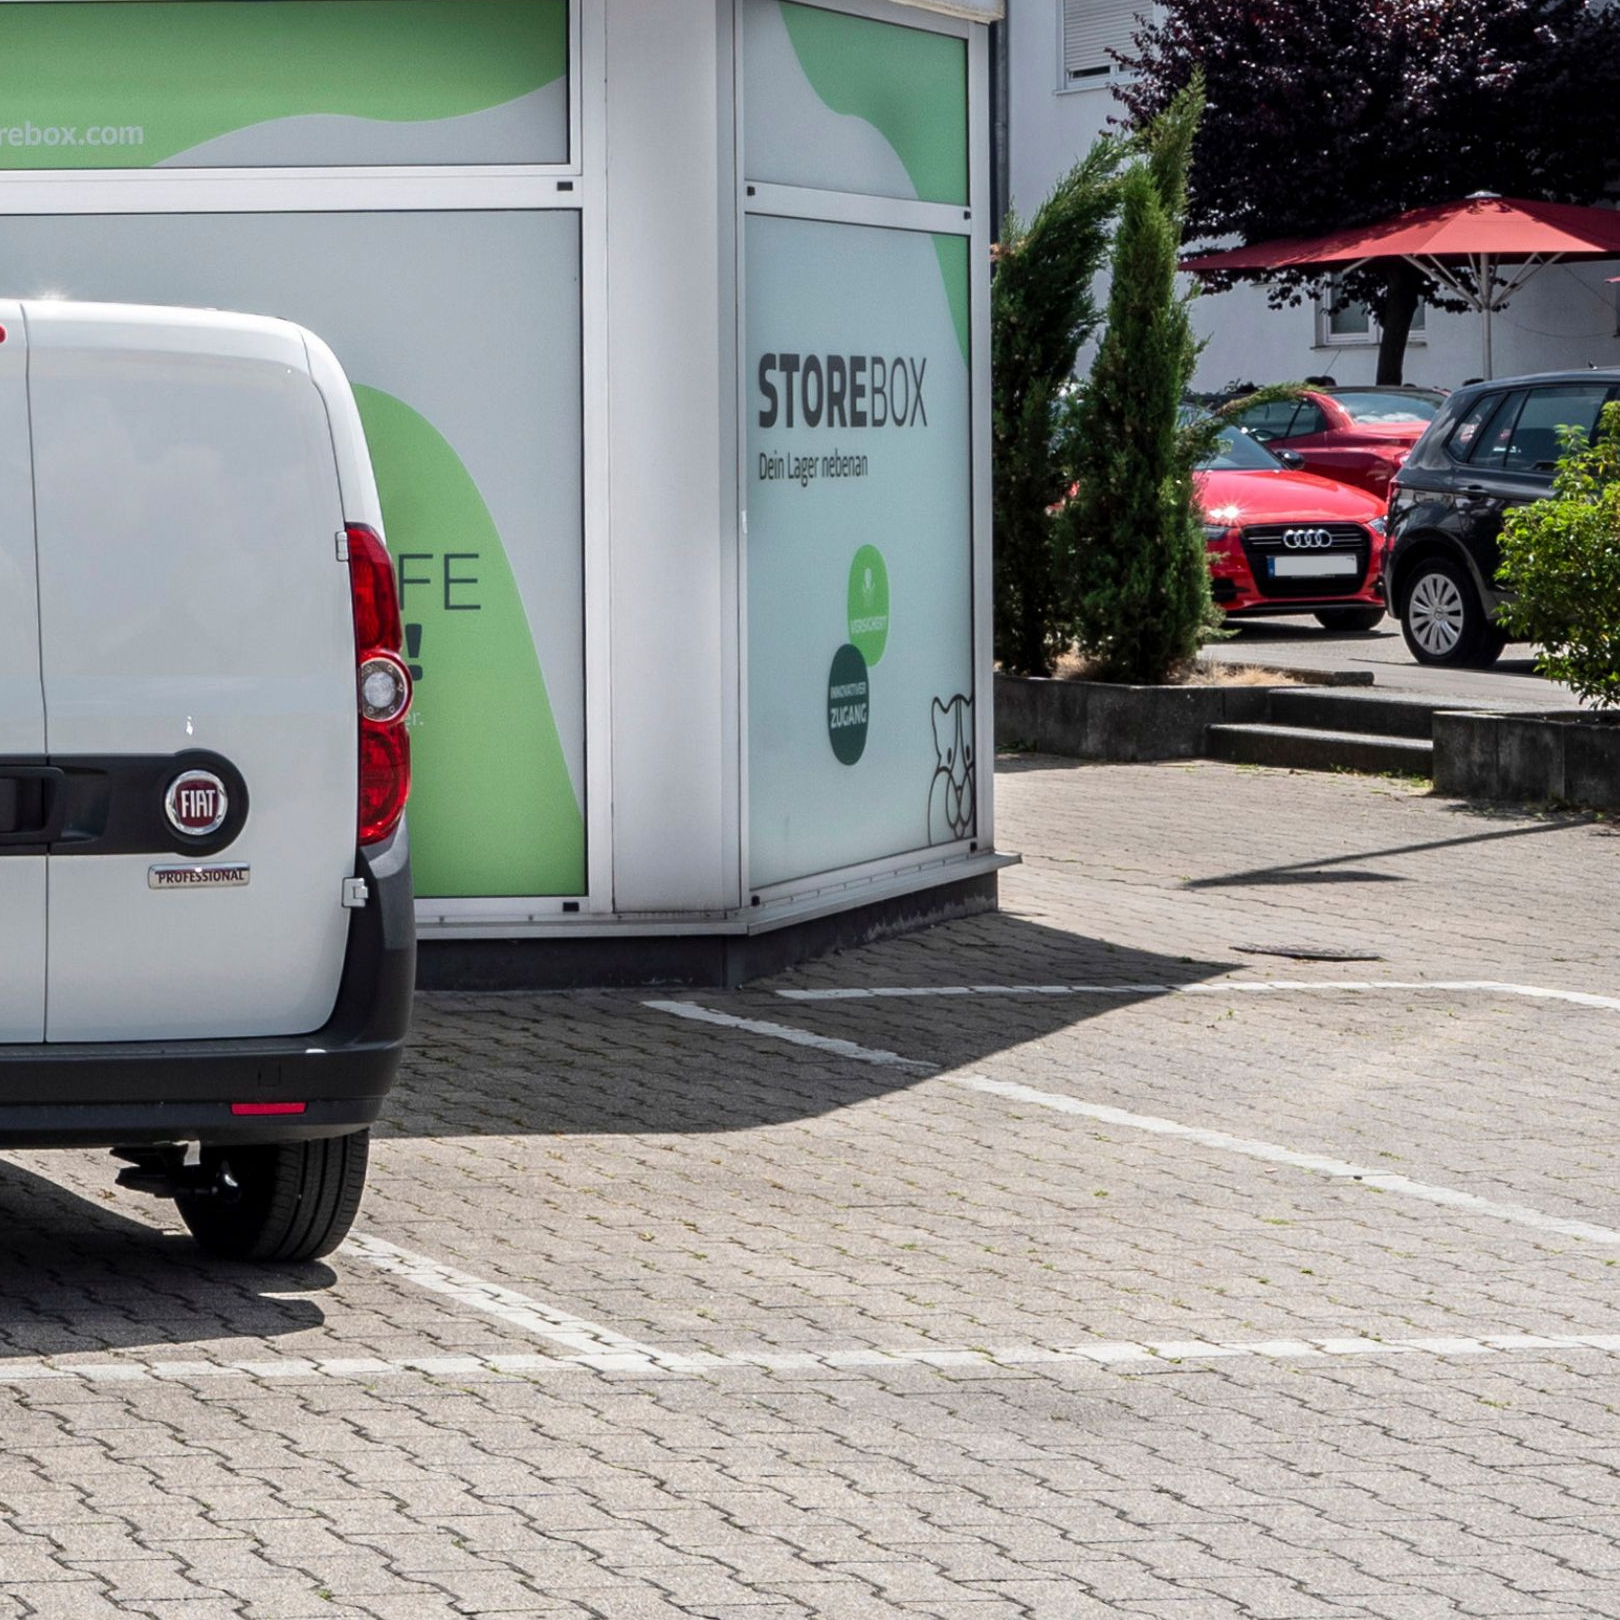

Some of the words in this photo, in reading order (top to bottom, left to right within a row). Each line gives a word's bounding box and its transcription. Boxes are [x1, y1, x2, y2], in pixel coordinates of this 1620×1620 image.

[758, 352, 928, 428] STOREBOX
[759, 449, 785, 481] Dein
[787, 452, 820, 488] Lager
[822, 448, 868, 478] nebenan
[830, 703, 867, 729] ZUGANG
[180, 789, 216, 819] FIAT
[157, 870, 245, 885] PROFESSIONAL
